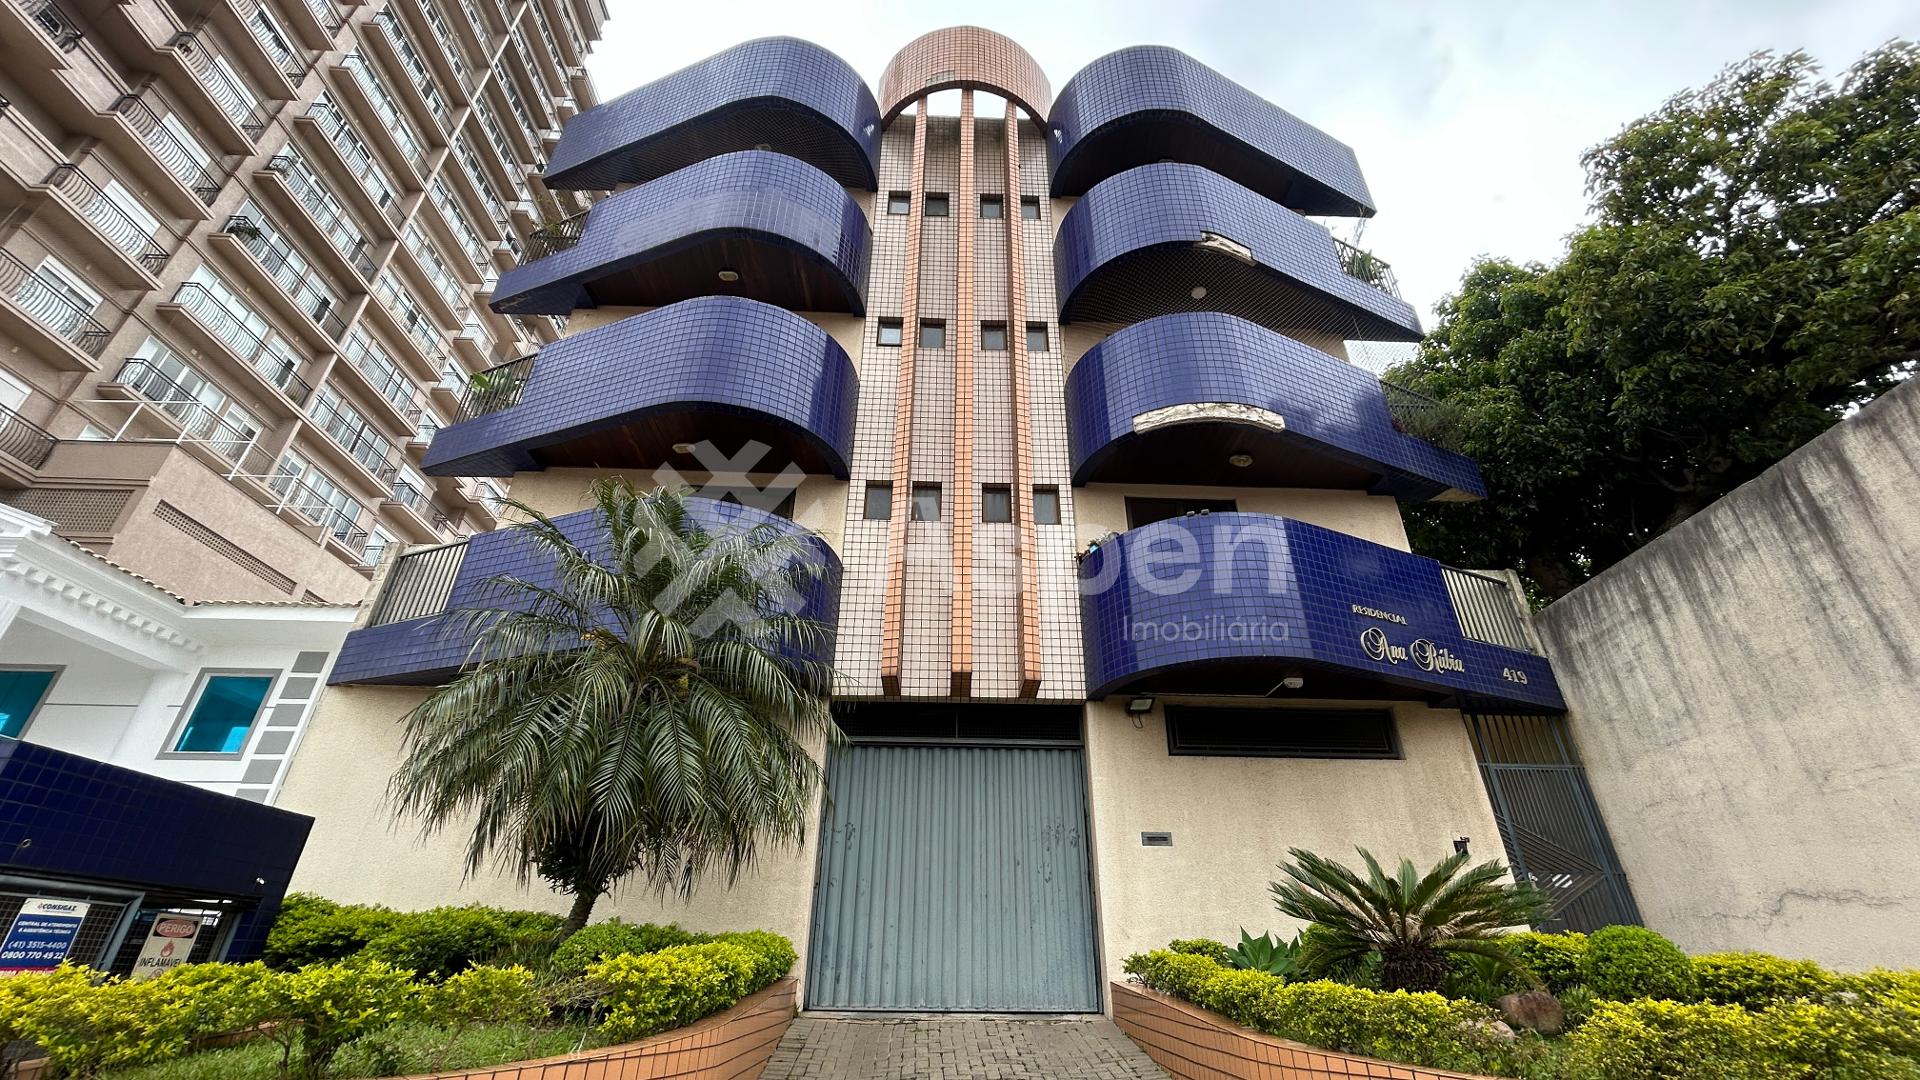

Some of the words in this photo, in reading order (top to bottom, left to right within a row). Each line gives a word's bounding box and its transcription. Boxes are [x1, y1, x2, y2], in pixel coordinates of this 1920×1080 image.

[1352, 604, 1408, 625] RESIDENCIAL
[1360, 627, 1409, 665] Ana
[1409, 638, 1465, 674] Rúbia
[1503, 667, 1528, 685] 419
[160, 923, 193, 934] PERIGO
[8, 940, 26, 949] (41)
[26, 940, 67, 949] 3515-4400
[1, 951, 26, 959] 0800
[26, 951, 42, 959] 770
